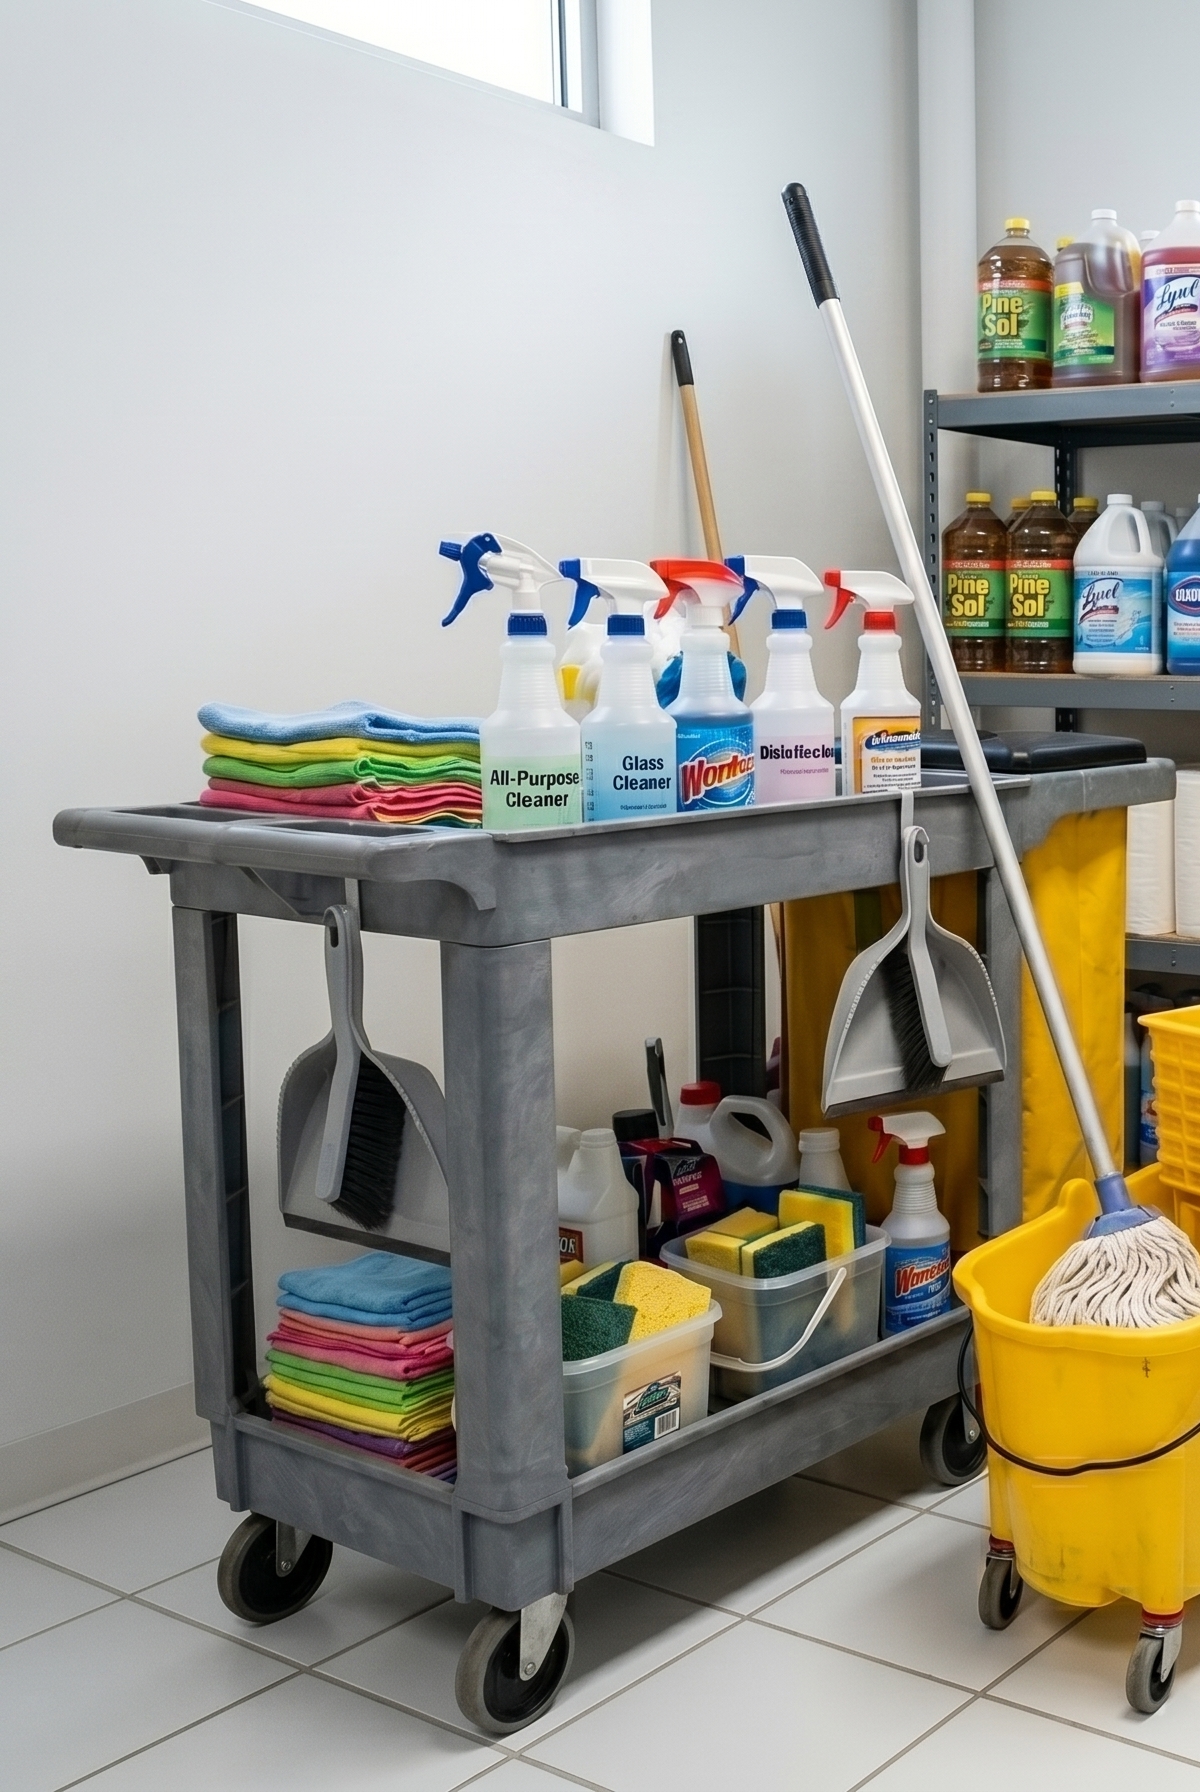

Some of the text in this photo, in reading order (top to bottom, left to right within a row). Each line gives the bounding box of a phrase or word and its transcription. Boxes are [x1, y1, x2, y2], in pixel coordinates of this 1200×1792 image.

[981, 293, 1023, 314] Pine
[984, 314, 1018, 336] Sol
[947, 573, 989, 595] Pine
[1009, 573, 1050, 595] Pine
[951, 593, 985, 617] Sol
[1012, 593, 1045, 617] Sol
[622, 755, 664, 771] Glass
[490, 769, 580, 790] All-Purpose
[612, 774, 672, 791] Cleaner
[505, 791, 569, 808] Cleaner
